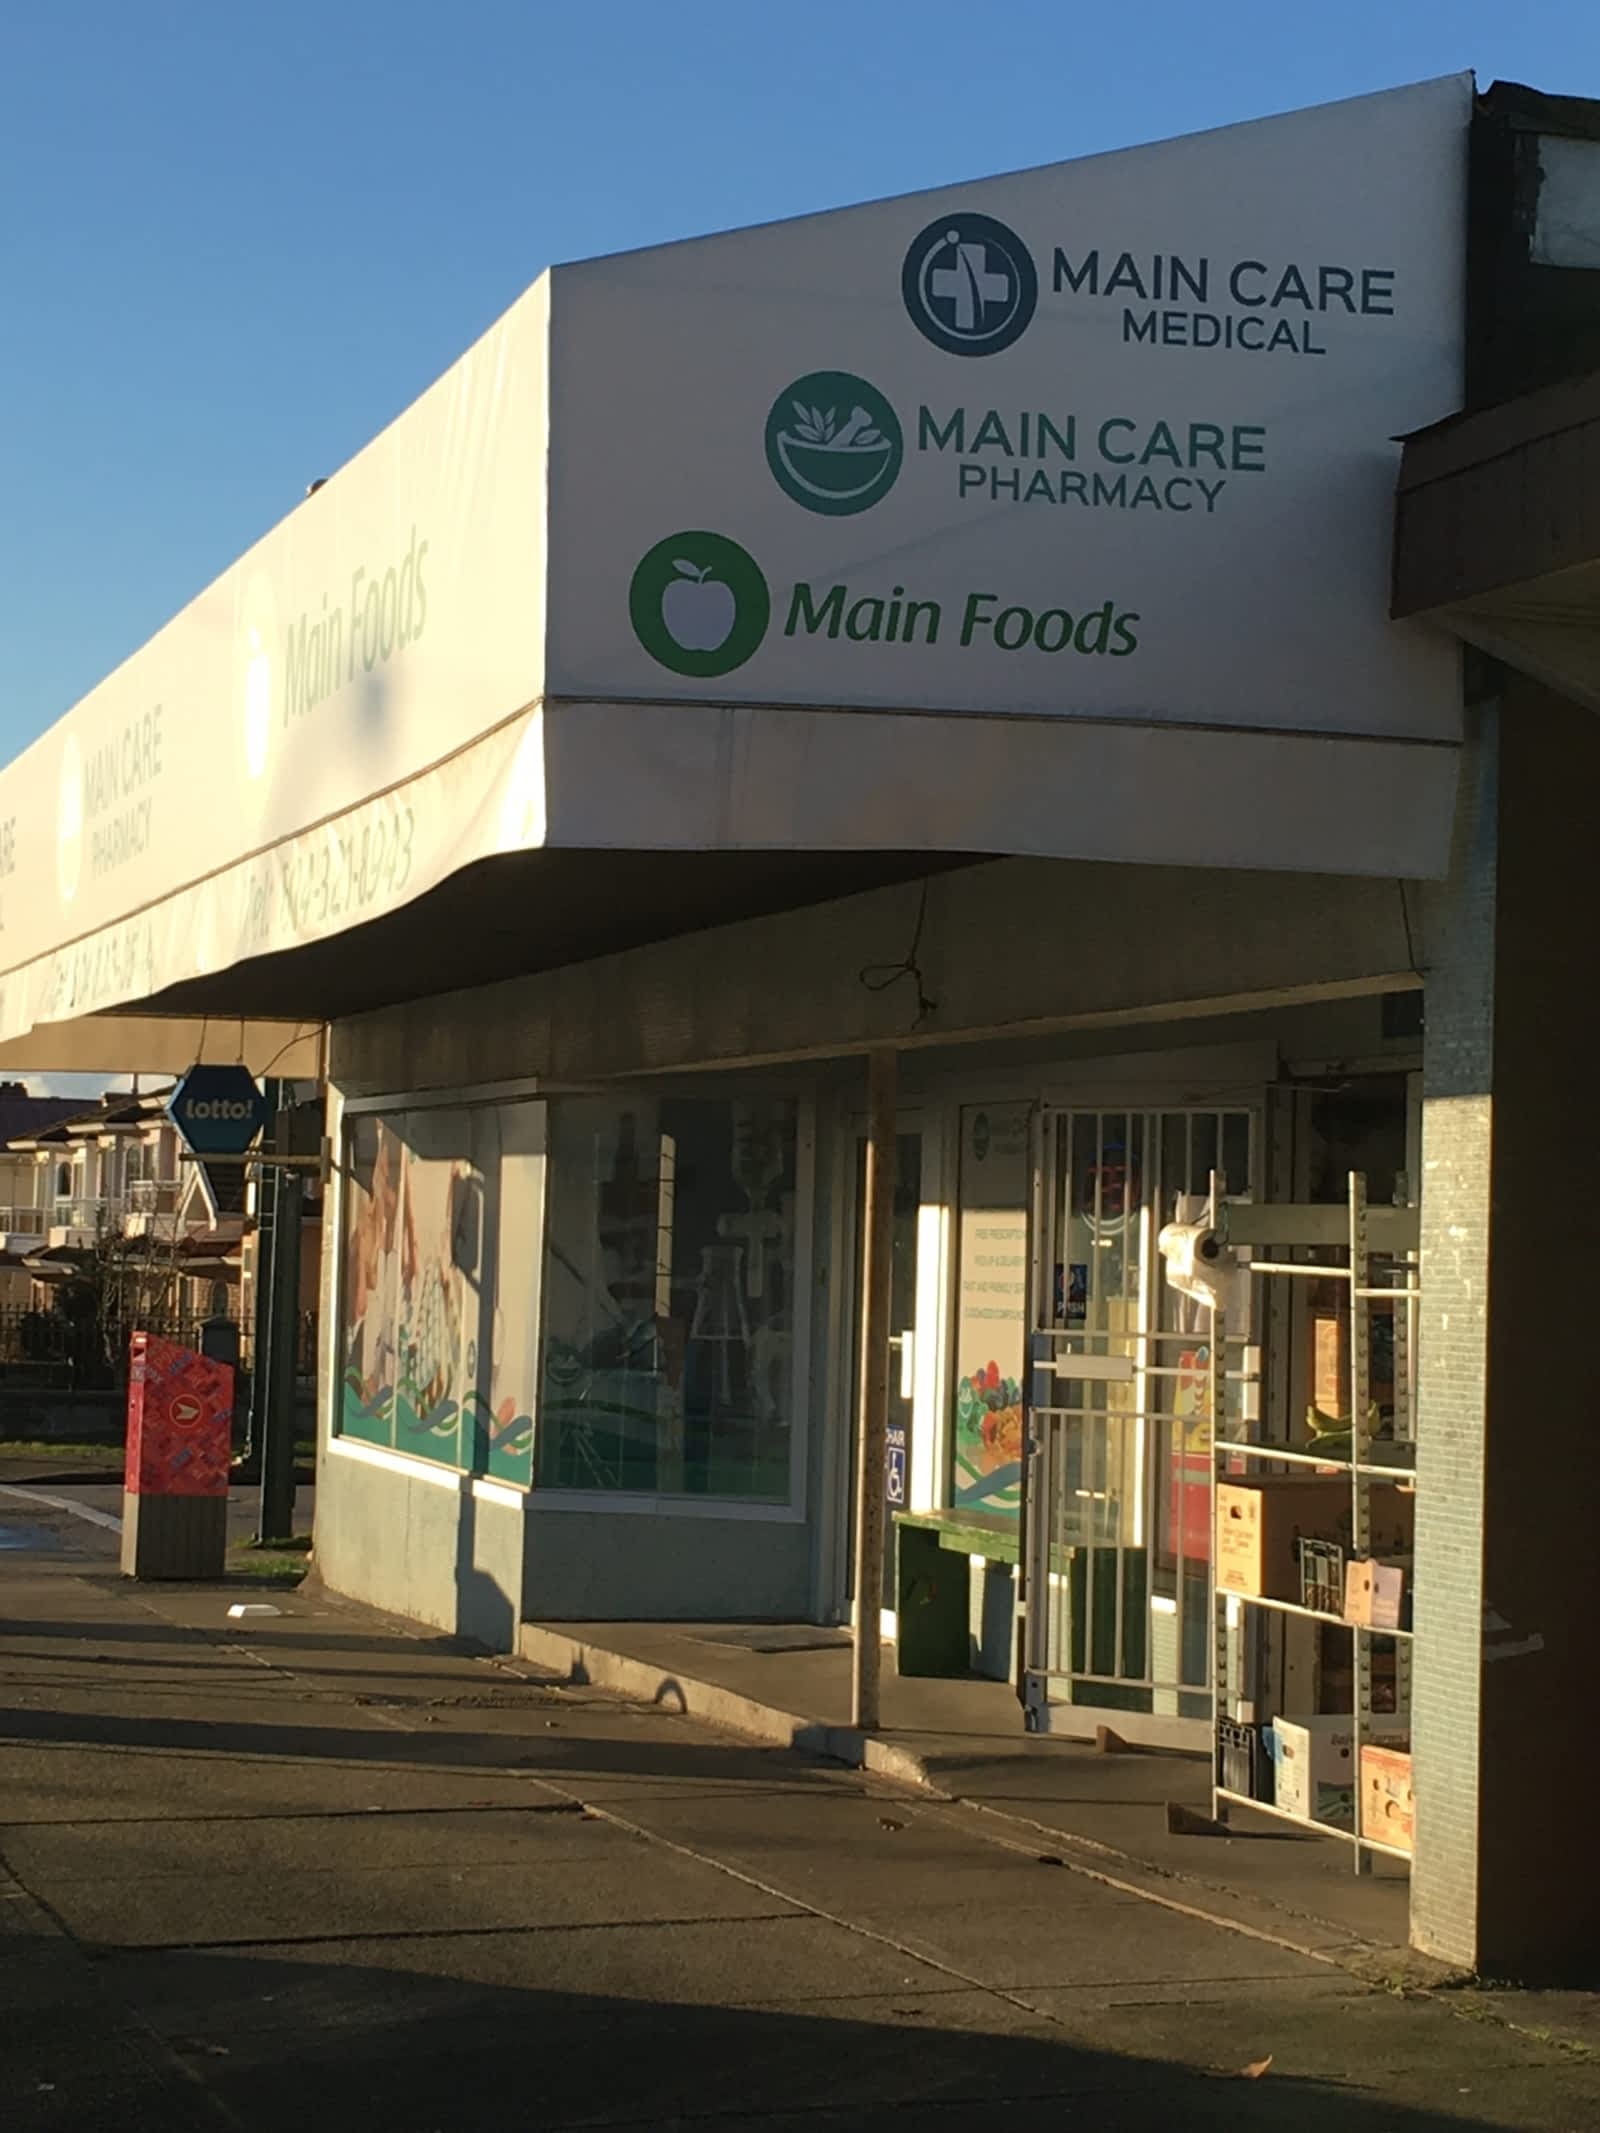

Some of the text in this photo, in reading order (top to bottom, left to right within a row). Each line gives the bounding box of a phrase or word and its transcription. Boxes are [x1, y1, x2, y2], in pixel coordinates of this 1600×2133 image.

[1053, 247, 1395, 315] MAIN CARE
[1123, 308, 1326, 355] MEDICAL
[919, 405, 1266, 472] MAIN CARE
[959, 464, 1226, 512] PHARMACY
[284, 524, 428, 727] Main Foods
[784, 583, 1140, 656] Main Foods
[85, 703, 162, 818] MAIN CARE
[92, 797, 152, 880] PHARMACY
[186, 1098, 254, 1119] lotto!
